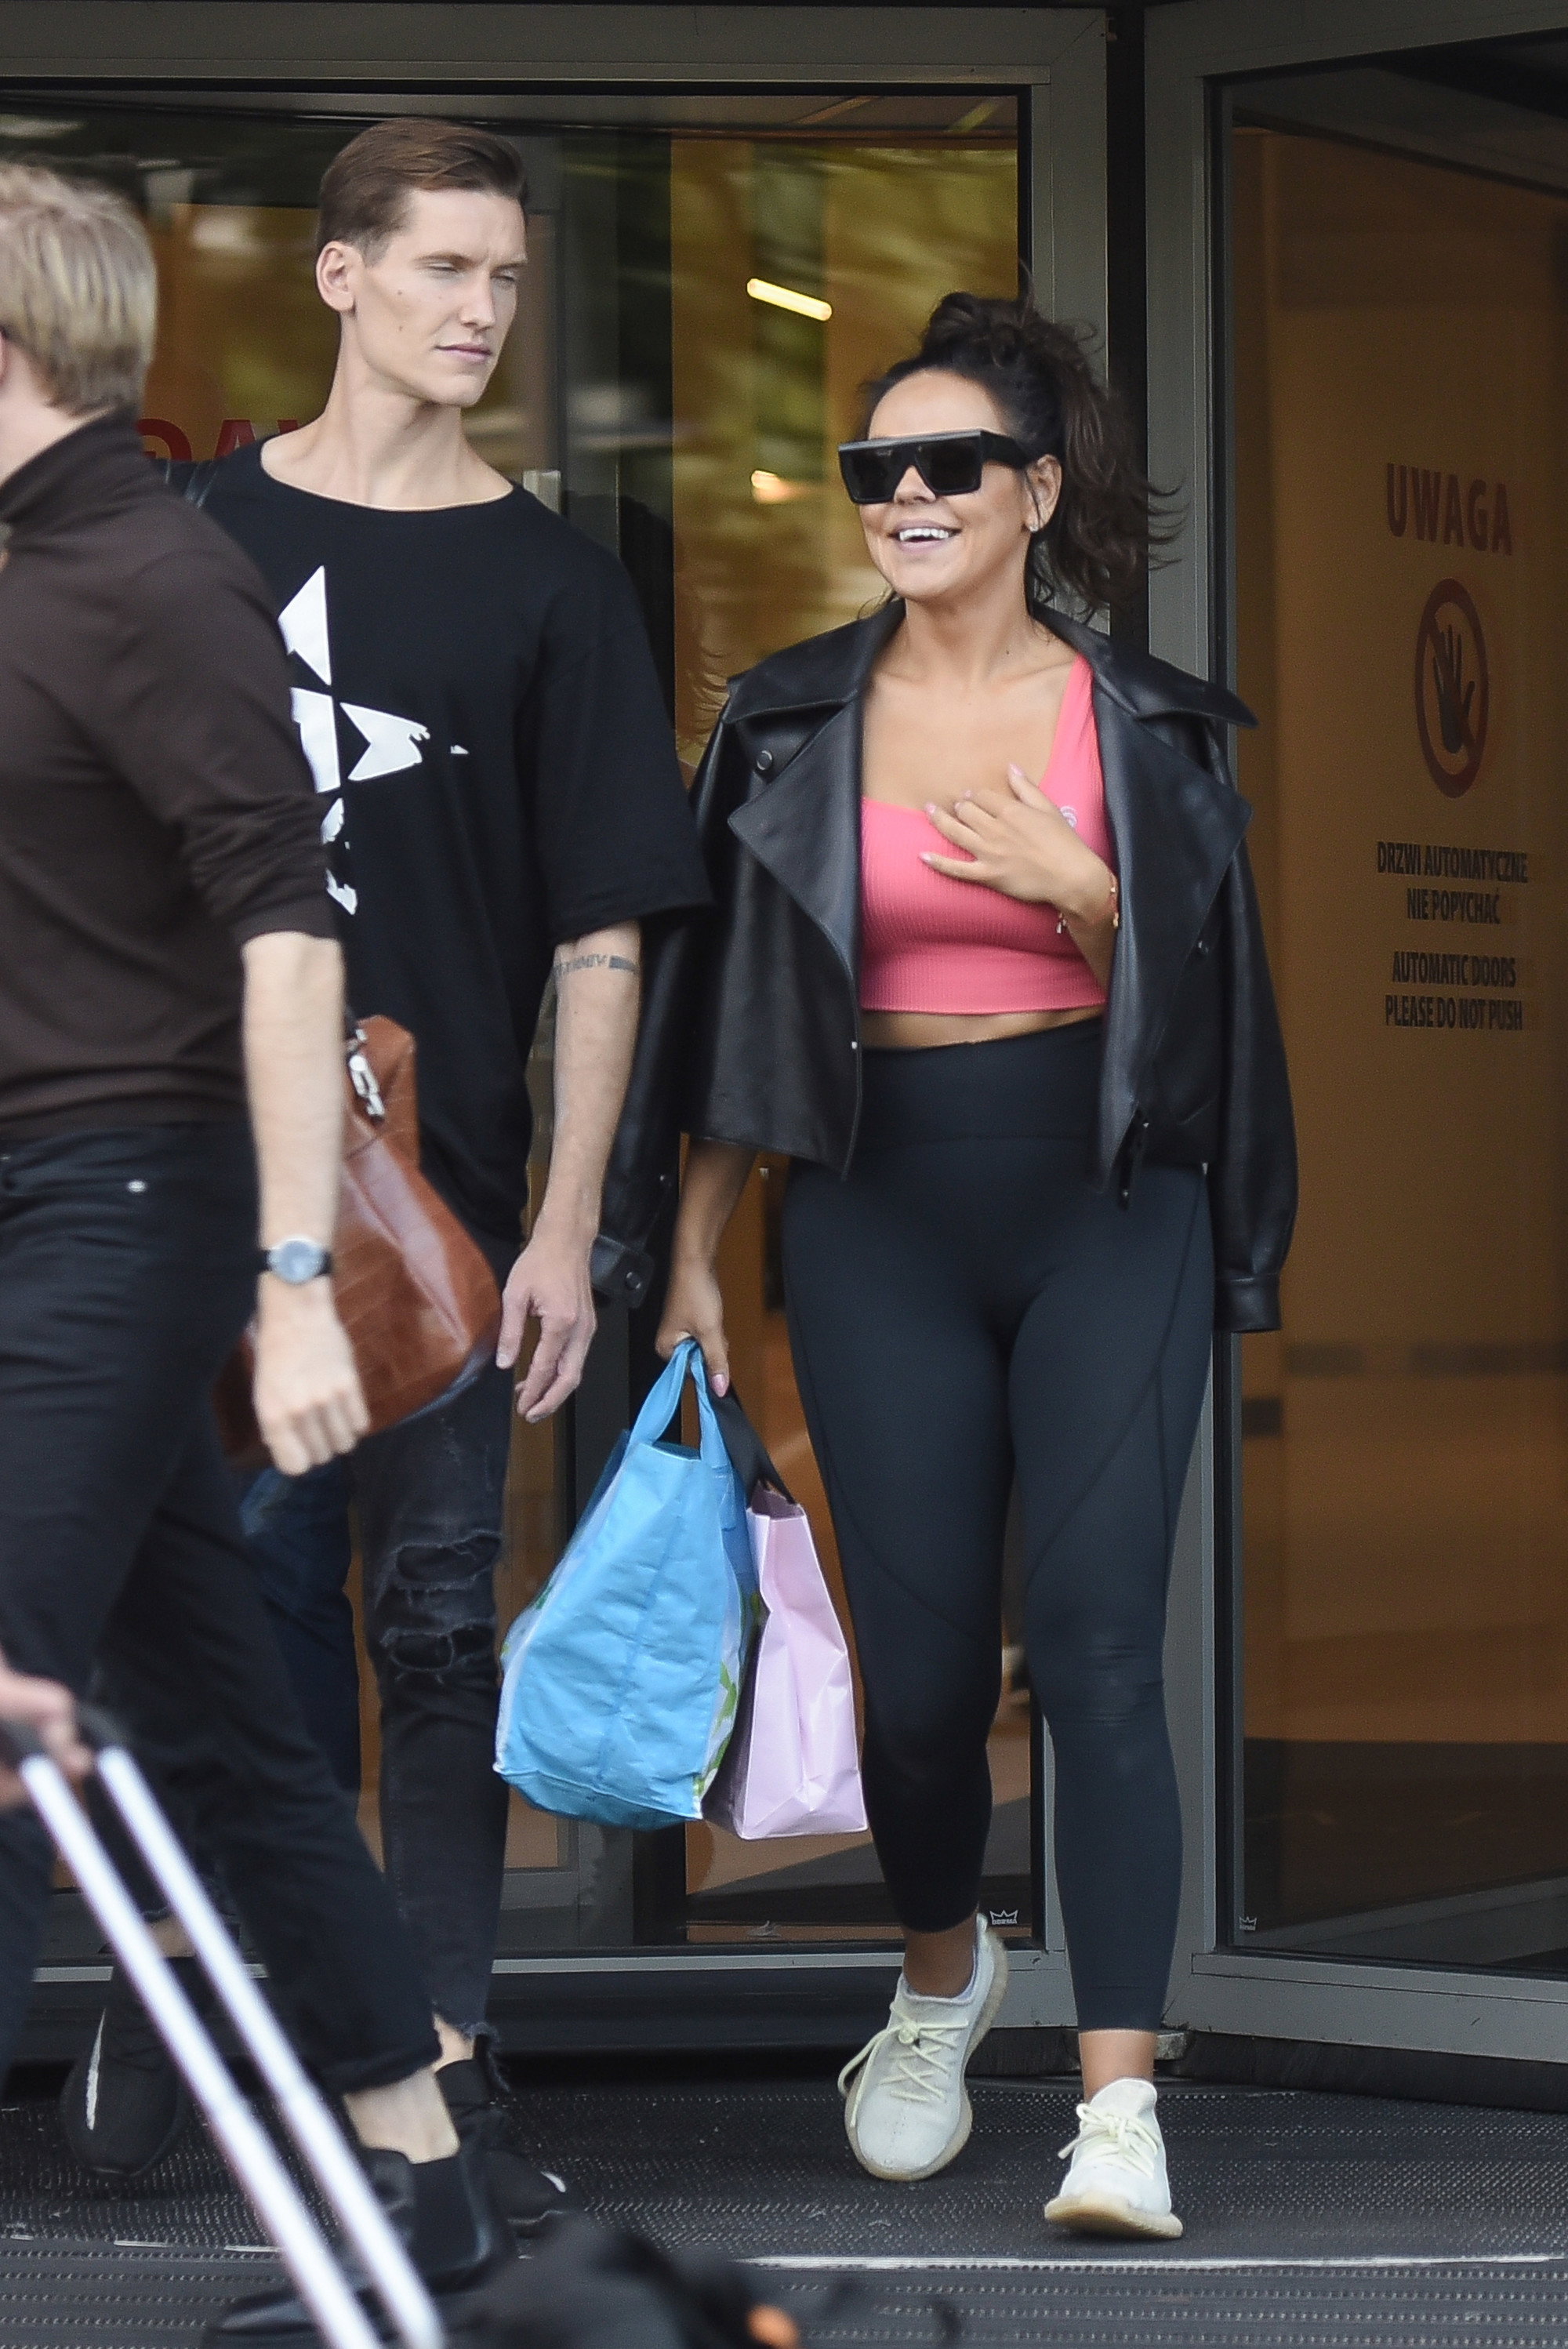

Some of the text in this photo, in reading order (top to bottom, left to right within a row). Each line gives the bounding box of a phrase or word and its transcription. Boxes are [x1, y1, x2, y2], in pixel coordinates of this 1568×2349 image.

[1387, 463, 1512, 556] UWAGA
[1377, 841, 1528, 883] DRZWI AUTOMATYCZNE
[1407, 888, 1428, 920] NIE
[1393, 951, 1517, 988] AUTOMATIC DOORS
[1385, 995, 1523, 1030] PLEASE DO NOT PUSH
